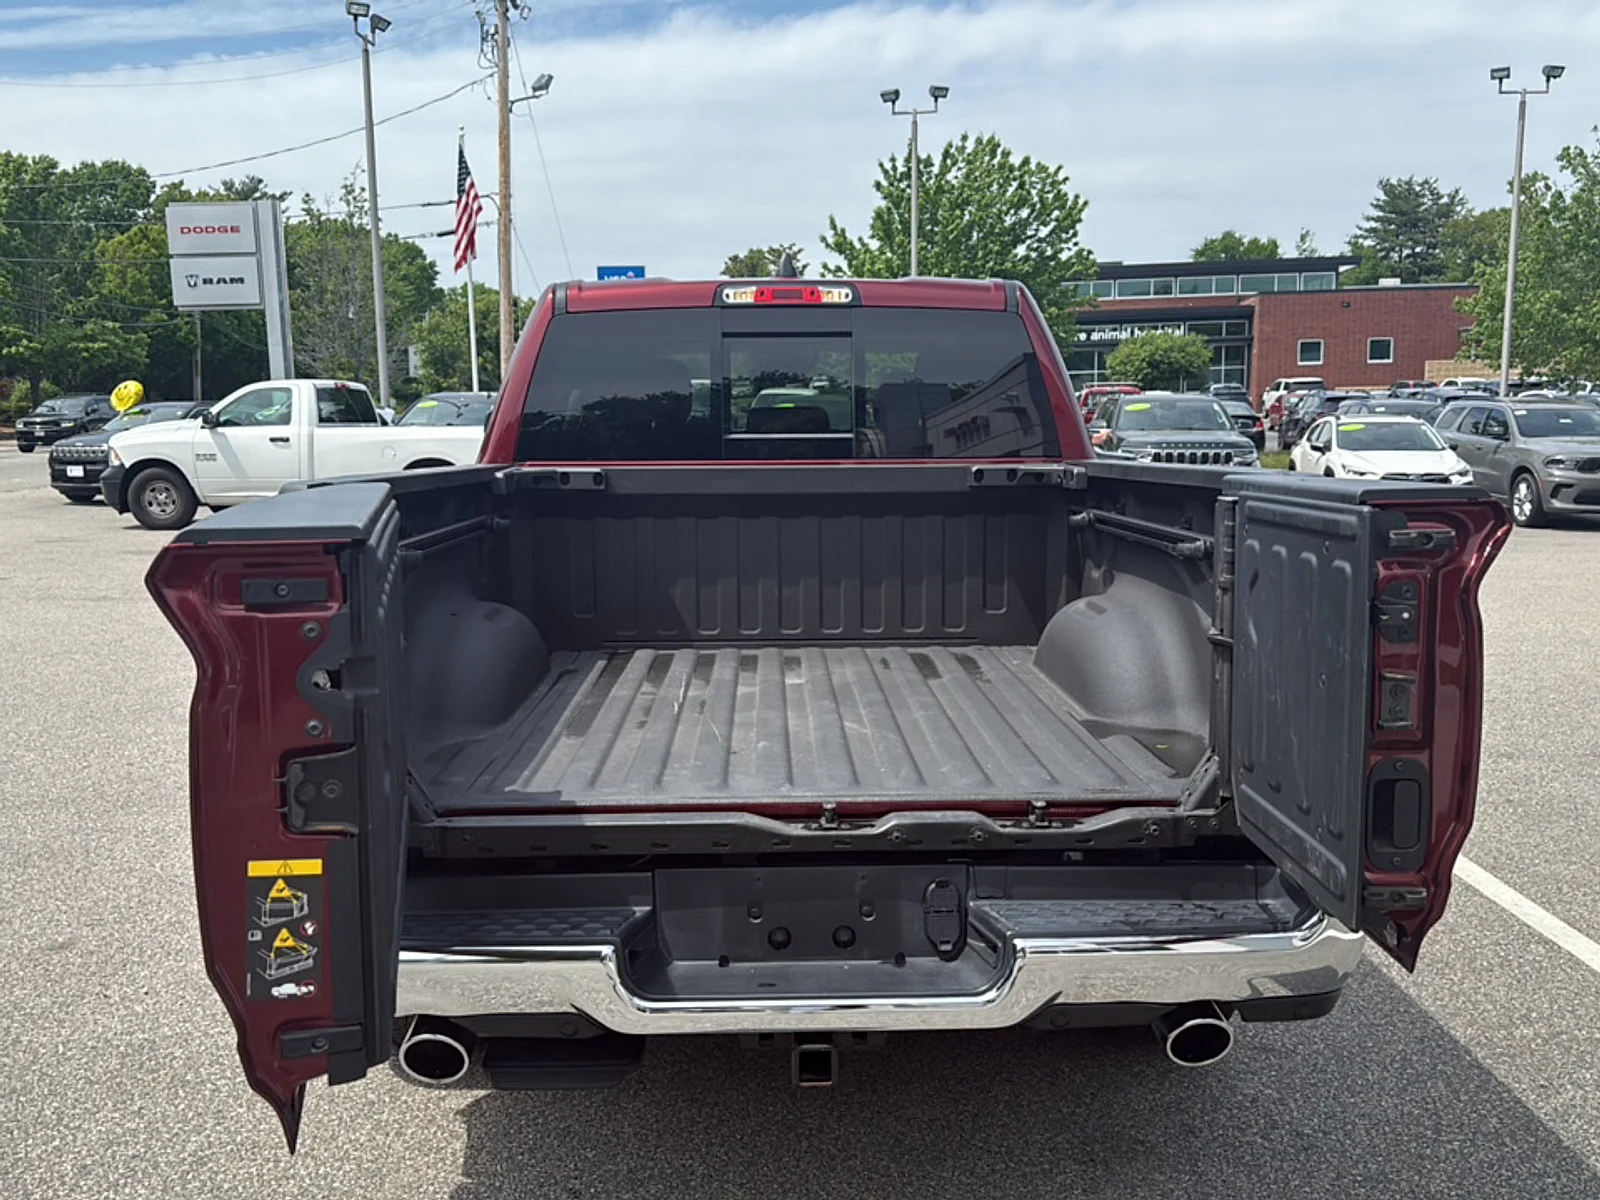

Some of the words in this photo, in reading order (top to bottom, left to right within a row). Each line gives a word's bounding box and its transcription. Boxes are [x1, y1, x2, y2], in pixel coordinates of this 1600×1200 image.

[179, 225, 241, 235] DODGE
[201, 276, 245, 285] RAM
[1089, 327, 1131, 341] animal
